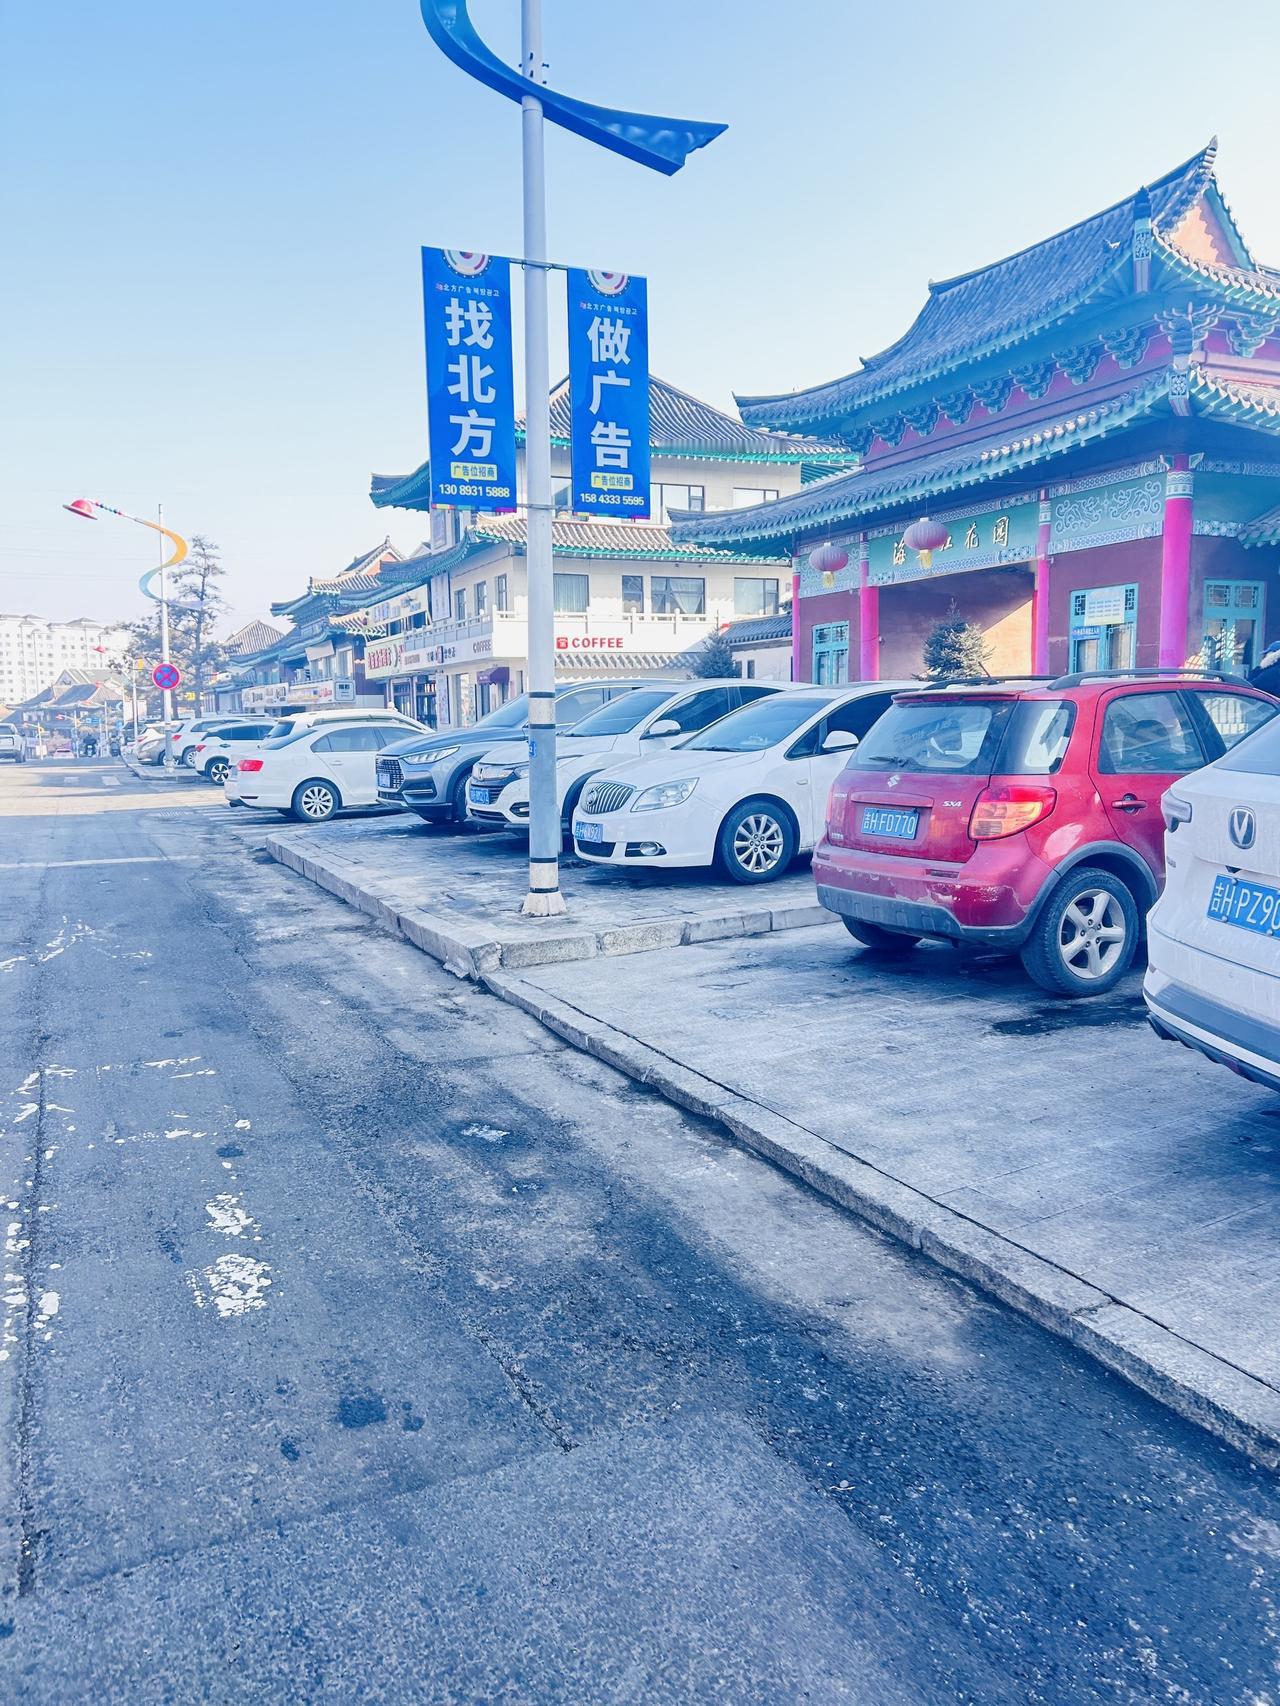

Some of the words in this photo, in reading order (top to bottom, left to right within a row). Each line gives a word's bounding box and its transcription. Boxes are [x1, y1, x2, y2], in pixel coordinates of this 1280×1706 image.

[445, 297, 496, 458] 找北方
[586, 316, 631, 469] 做广告
[453, 464, 496, 479] 广告位招商
[592, 474, 631, 488] 广告位招商
[438, 484, 458, 495] 130
[459, 485, 483, 497] 8931
[486, 486, 510, 498] 5888
[580, 492, 598, 503] 158
[598, 493, 620, 505] 4333
[622, 495, 644, 506] 5595
[572, 637, 623, 648] COFFEE
